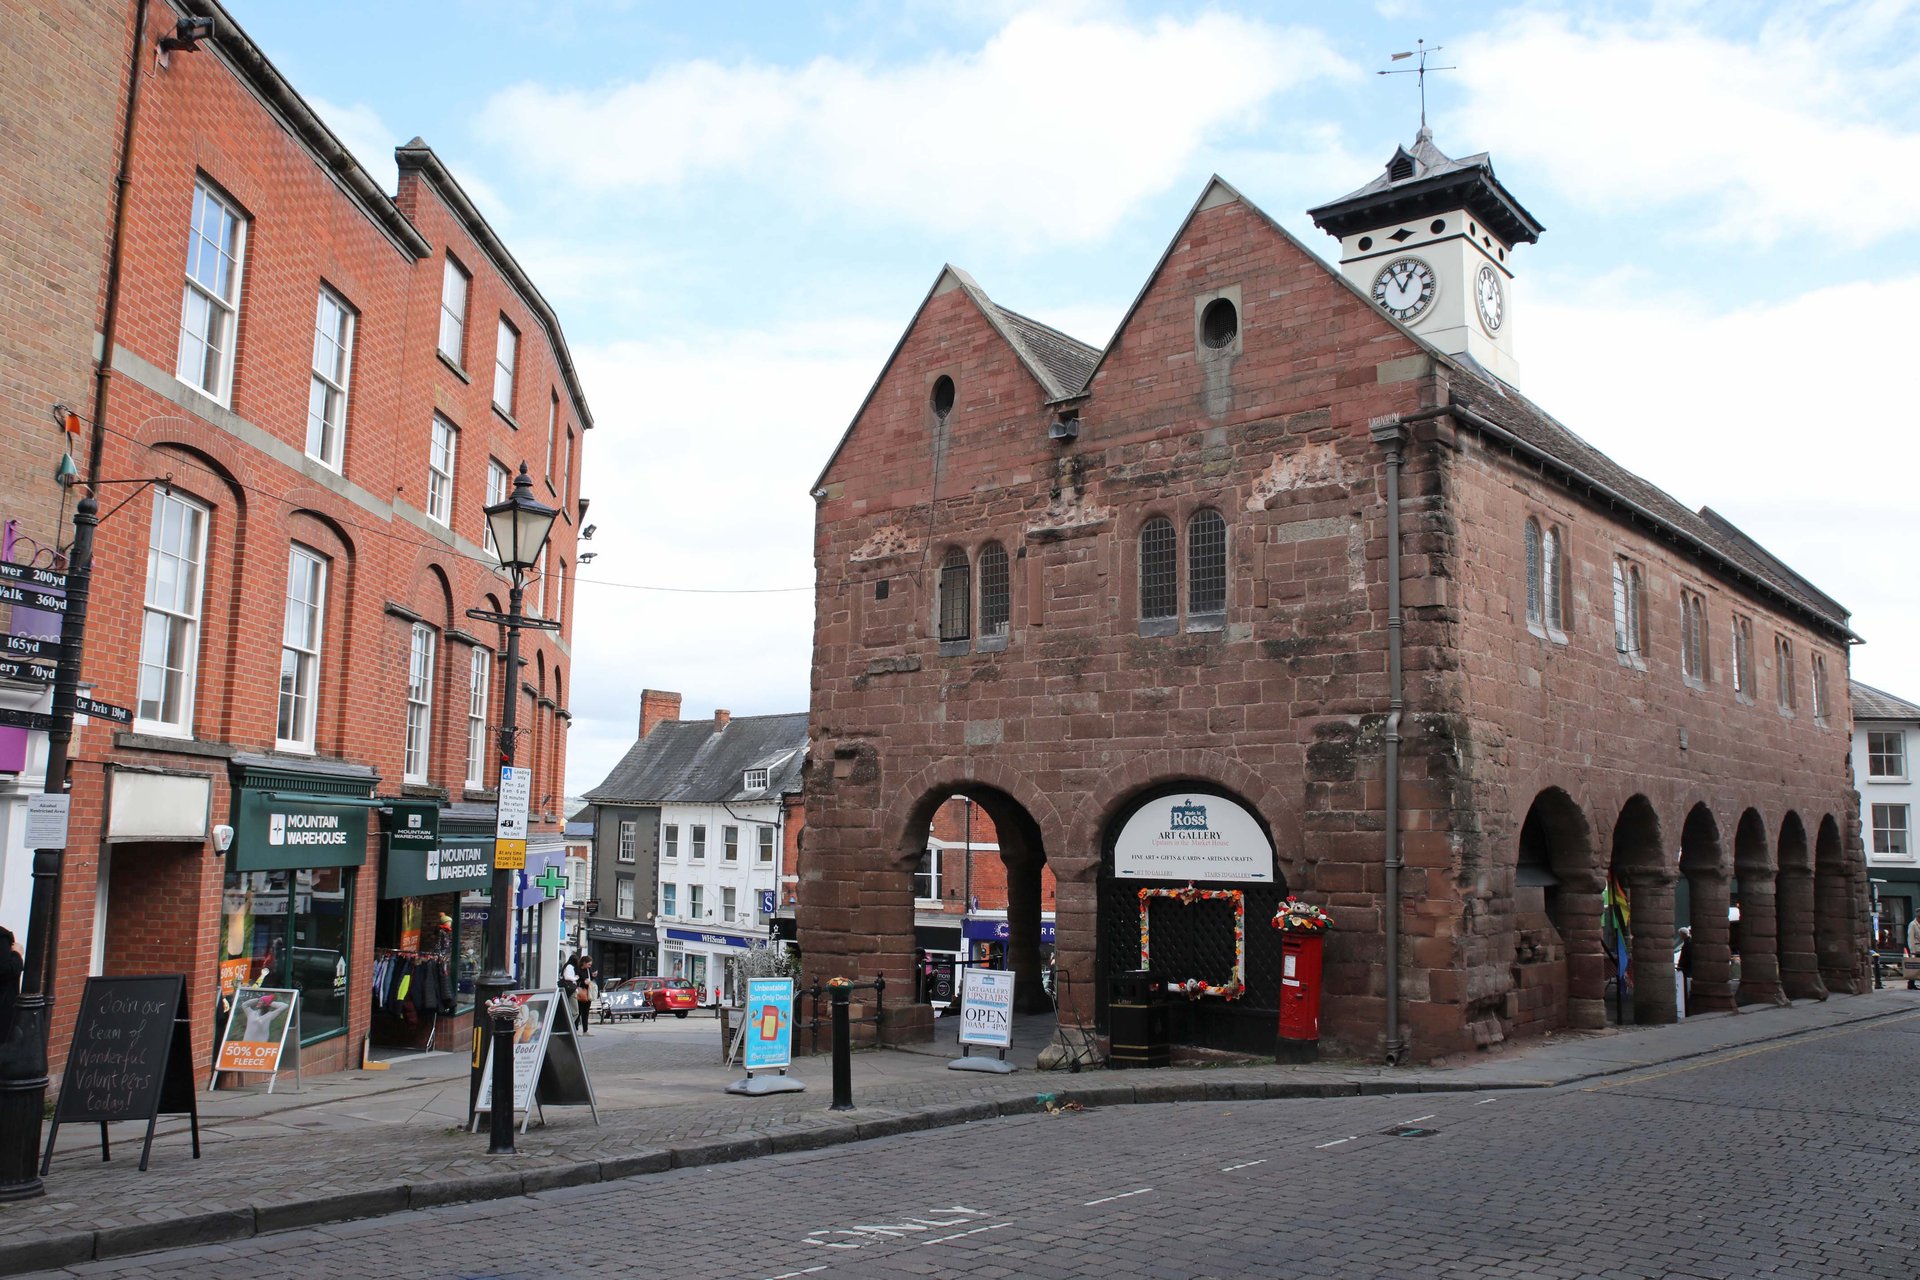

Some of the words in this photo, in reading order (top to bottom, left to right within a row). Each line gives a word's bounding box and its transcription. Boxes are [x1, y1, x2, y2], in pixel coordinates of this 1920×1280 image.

[33, 570, 66, 586] 200yd
[36, 594, 67, 611] 360yd
[7, 637, 40, 653] 165yd
[30, 665, 55, 680] 70yd
[76, 698, 87, 710] Car
[91, 703, 108, 714] Parks
[111, 707, 126, 721] 130yd
[514, 769, 530, 777] Loading
[287, 814, 339, 829] MOUNTAIN
[286, 831, 347, 845] WAREHOUSE
[1152, 839, 1173, 847] Upstairs
[1158, 832, 1175, 840] ART
[1178, 831, 1222, 840] GALLERY
[441, 848, 481, 862] MOUNTAIN
[440, 863, 488, 879] WAREHOUSE
[764, 897, 773, 913] S
[701, 934, 727, 945] WHSmith
[754, 984, 787, 992] Unbeatable
[99, 990, 138, 1015] Join
[141, 1000, 167, 1016] our
[761, 994, 775, 1003] Only
[967, 992, 1009, 1003] UPSTAIRS
[965, 1008, 1008, 1023] OPEN
[965, 1020, 985, 1029] 10AM
[991, 1023, 1008, 1031] 4PM
[88, 1020, 121, 1040] team
[129, 1019, 148, 1048] of
[225, 1046, 252, 1056] 50%
[255, 1047, 278, 1057] OFF
[233, 1057, 265, 1066] FLEECE
[87, 1090, 133, 1113] today!
[801, 1206, 988, 1248] ONLY
